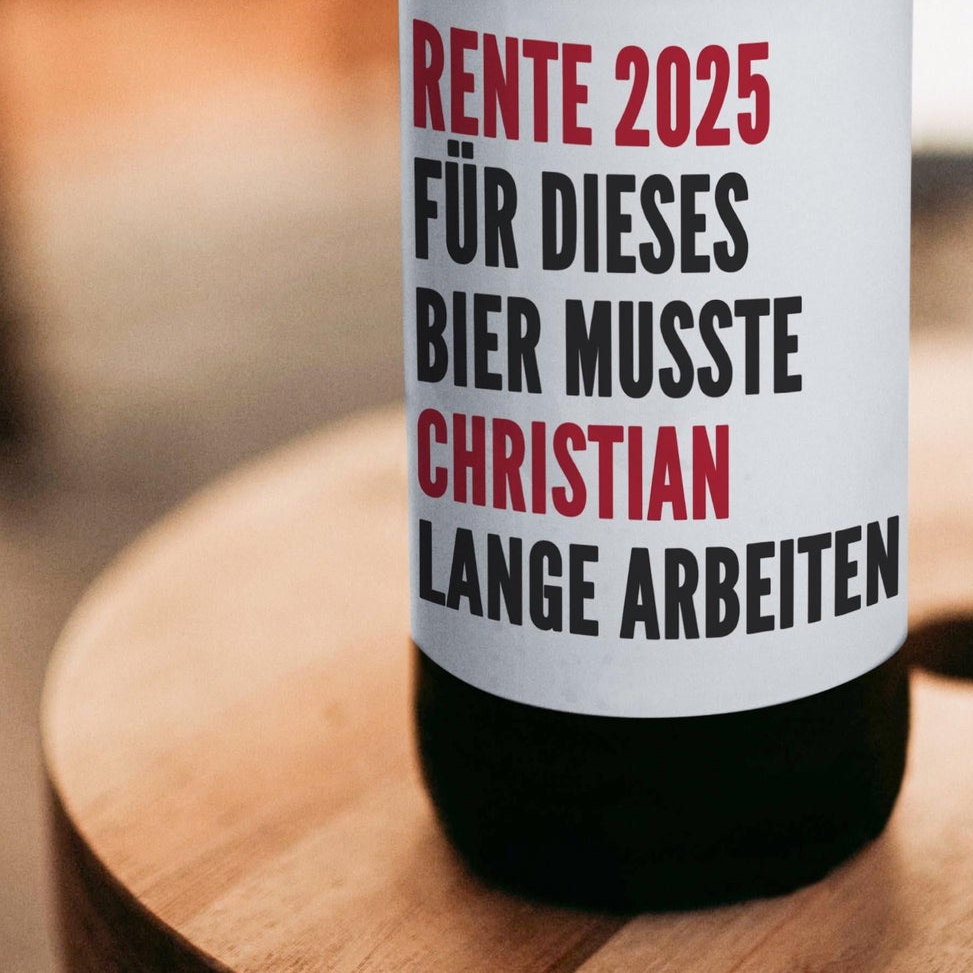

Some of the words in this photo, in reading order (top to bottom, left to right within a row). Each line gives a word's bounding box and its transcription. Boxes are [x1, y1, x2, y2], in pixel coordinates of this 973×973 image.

[412, 17, 593, 146] RENTE
[614, 41, 771, 148] 2025
[413, 138, 519, 269] FÜR
[541, 170, 749, 275] DIESES
[415, 286, 543, 396] BIER
[565, 295, 803, 399] MUSSTE
[416, 407, 730, 522] CHRISTIAN
[418, 518, 599, 638] LANGE
[619, 515, 900, 641] ARBEITEN
